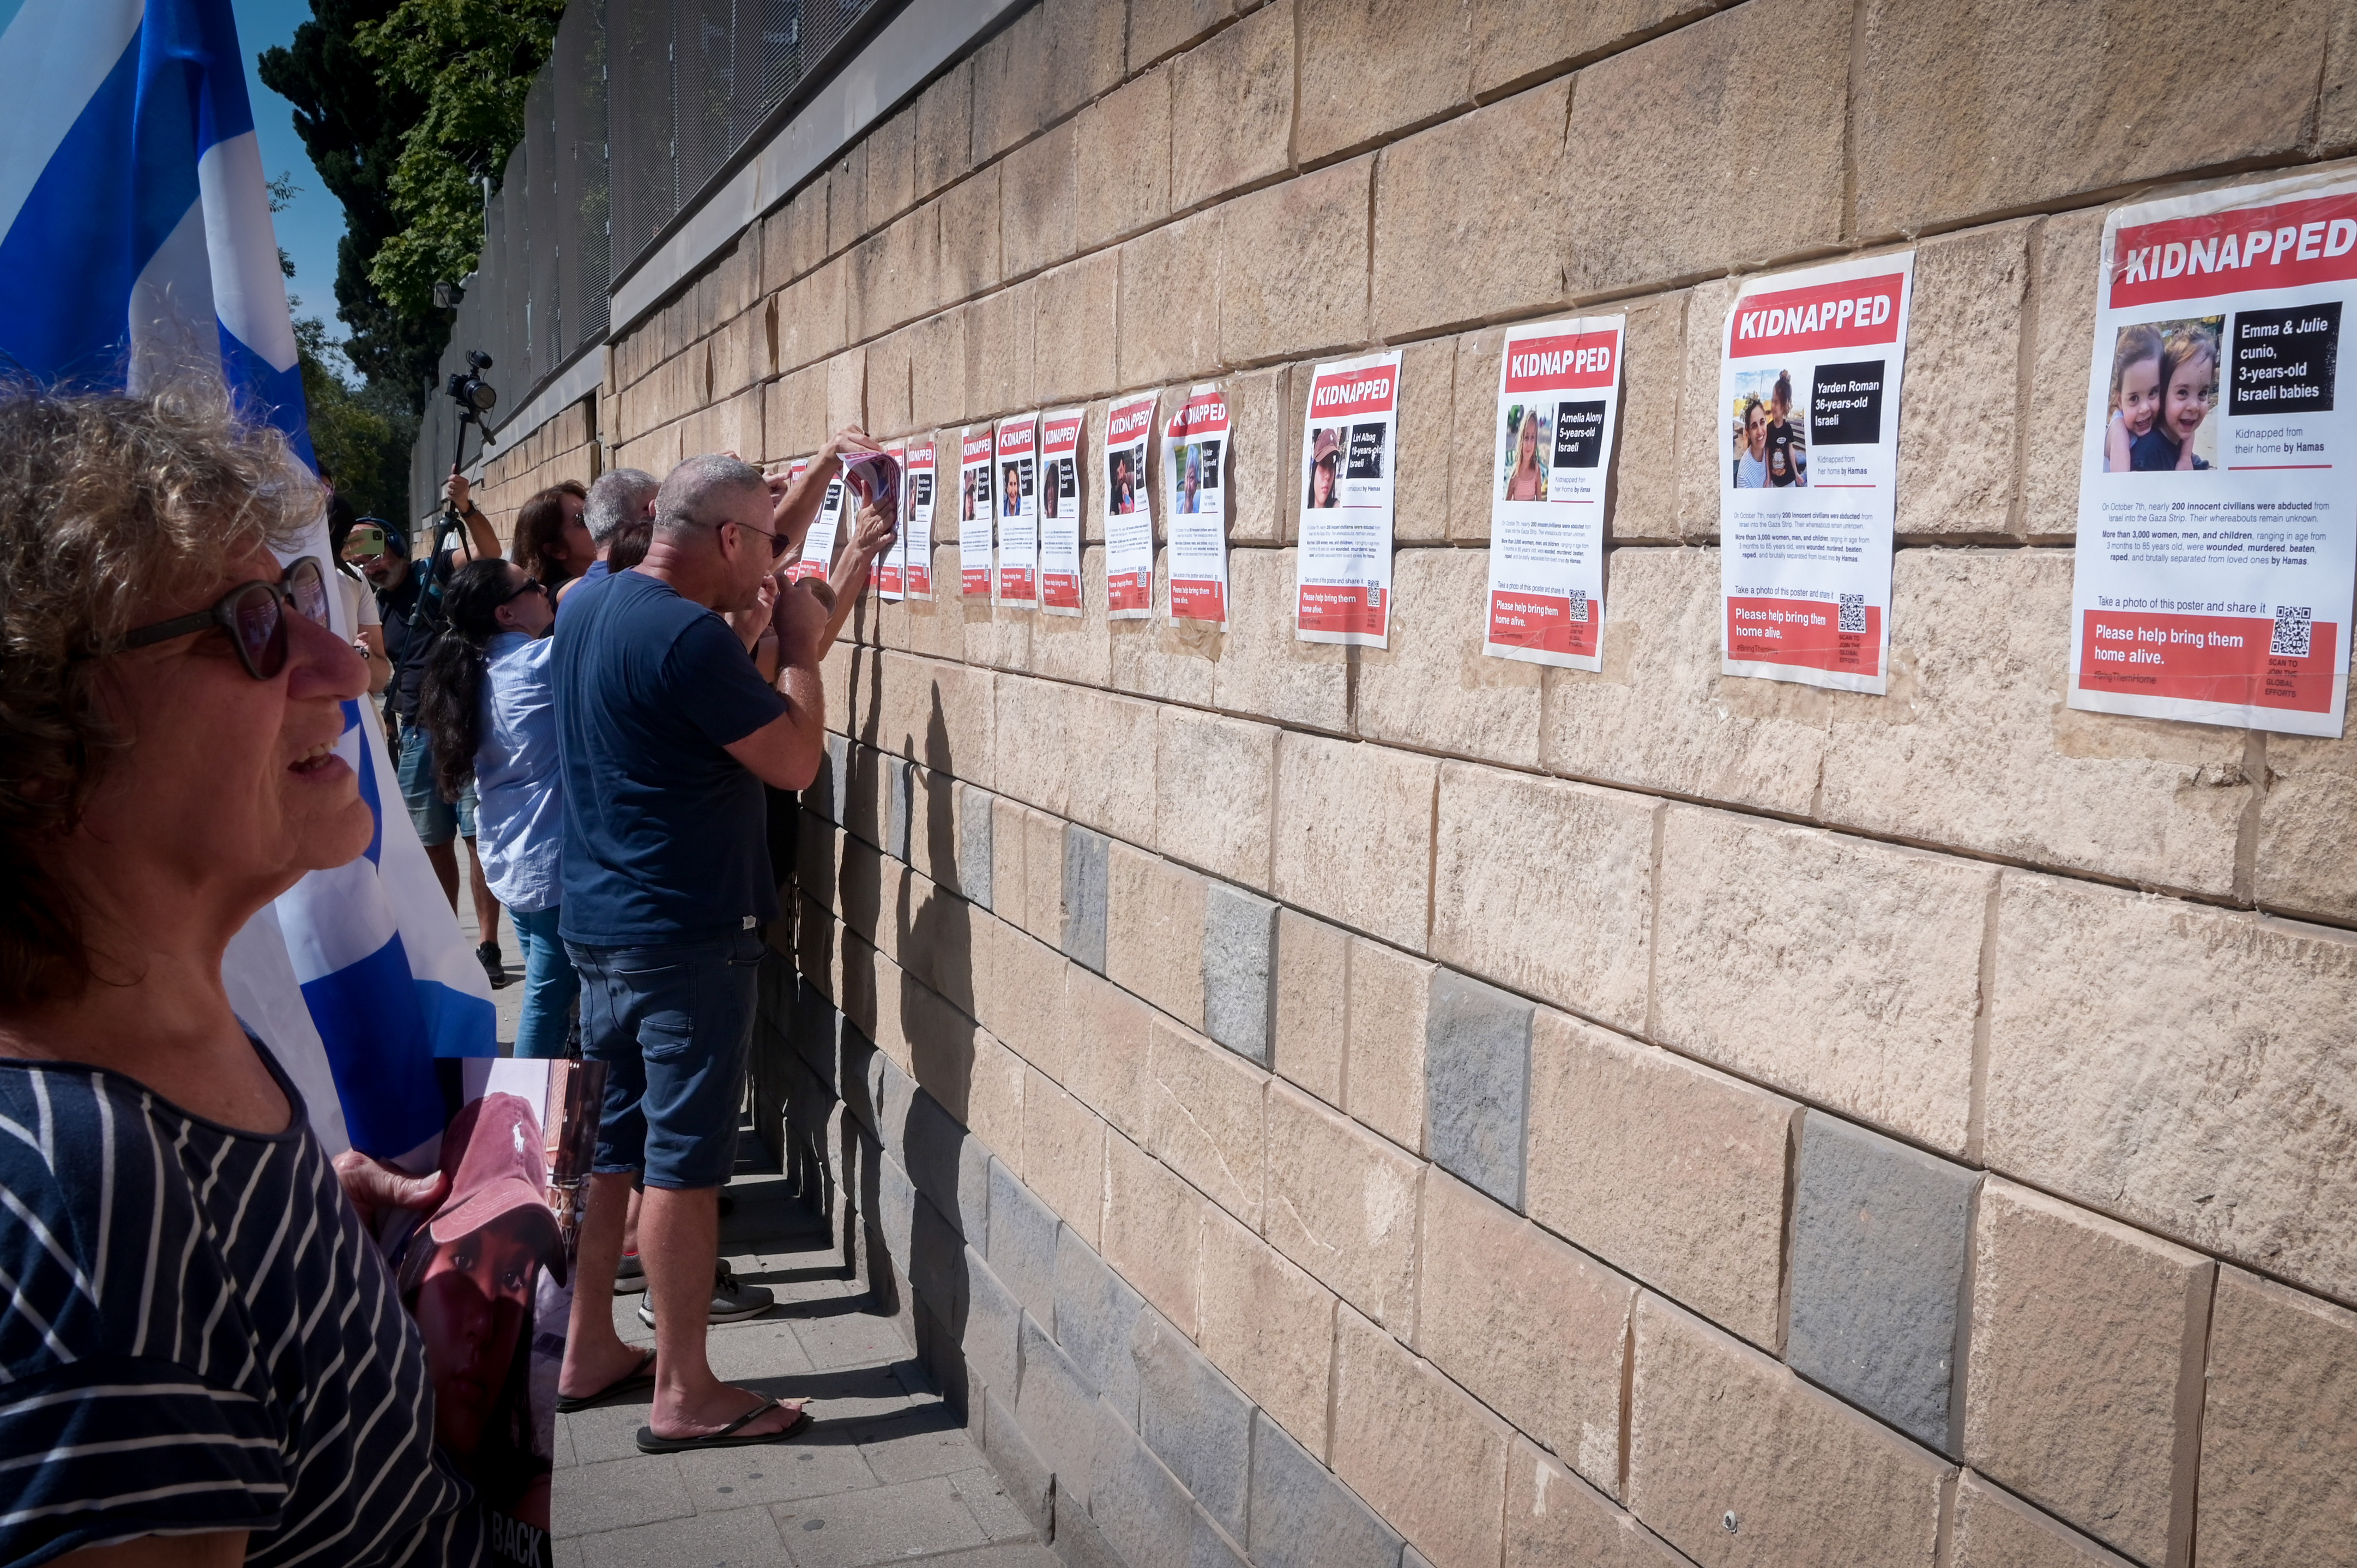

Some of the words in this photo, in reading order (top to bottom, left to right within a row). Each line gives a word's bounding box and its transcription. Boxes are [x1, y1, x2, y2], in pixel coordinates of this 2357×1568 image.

[2126, 219, 2356, 284] KIDNAPPED
[1739, 295, 1890, 339] KIDNAPPED
[2242, 324, 2279, 338] Emma
[2283, 321, 2292, 334] &
[2296, 317, 2328, 334] Julie
[2241, 344, 2276, 359] cunio,
[1511, 347, 1609, 378] KIDNAPPED
[2239, 362, 2307, 383] 3-years-old
[1316, 378, 1389, 406] KIDNAPPED
[1818, 382, 1846, 394] Yarden
[1849, 381, 1879, 391] Roman
[2238, 385, 2276, 401] Israeli
[2280, 383, 2319, 399] babies
[1816, 396, 1868, 412] 36-years-old
[1560, 413, 1584, 423] Amelia
[1586, 412, 1602, 424] Alony
[1816, 414, 1838, 426] Israeli
[1001, 429, 1032, 447] KIDNAPPED
[1045, 426, 1075, 445] KIDNAPPED
[1361, 433, 1376, 443] Albag
[1559, 427, 1595, 439] 5-years-old
[2235, 428, 2283, 439] Kidnapped
[2286, 427, 2303, 436] from
[964, 438, 991, 456] KIDNAPPED
[1558, 442, 1579, 452] Israeli
[2235, 444, 2253, 453] their
[2257, 444, 2281, 453] home
[2284, 443, 2294, 454] by
[2296, 442, 2324, 451] Hamas
[1349, 459, 1364, 468] Israeli
[1817, 456, 1843, 464] Kidnapped
[1841, 468, 1846, 476] by
[2136, 503, 2147, 511] 7th,
[2149, 503, 2169, 512] nearly
[2314, 502, 2329, 510] from
[2149, 514, 2167, 522] Gaza
[2169, 514, 2186, 523] Strip.
[2259, 514, 2283, 522] remain
[2286, 515, 2318, 523] unknown.
[2152, 532, 2179, 540] women,
[2220, 532, 2254, 540] children,
[2257, 532, 2284, 541] ranging
[2295, 533, 2308, 542] age
[2311, 532, 2326, 540] from
[2172, 543, 2184, 551] old,
[2207, 544, 2244, 552] wounded,
[2248, 544, 2287, 553] murdered,
[2289, 545, 2316, 554] beaten,
[2111, 553, 2129, 562] raped,
[2146, 554, 2168, 563] brutally
[2171, 554, 2205, 563] separated
[2227, 556, 2248, 564] loved
[2271, 556, 2280, 566] by
[2283, 557, 2308, 565] Hamas.
[1324, 593, 1337, 604] bring
[1339, 594, 1356, 602] them
[1757, 587, 1773, 596] photo
[1791, 588, 1808, 597] poster
[1819, 590, 1830, 598] share
[1497, 600, 1513, 611] Please
[1515, 602, 1526, 614] help
[1528, 604, 1544, 617] bring
[1545, 605, 1558, 616] them
[2099, 596, 2113, 606] Take
[2123, 598, 2147, 609] photo
[2150, 598, 2158, 608] of
[2161, 599, 2174, 609] this
[2177, 601, 2204, 612] poster
[2207, 601, 2224, 611] and
[2227, 602, 2256, 613] share
[2260, 603, 2265, 613] it
[1496, 614, 1510, 624] home
[1511, 617, 1526, 626] alive.
[1736, 608, 1767, 620] Please
[1769, 609, 1783, 624] help
[1786, 611, 1809, 626] bring
[1811, 613, 1826, 625] them
[1737, 625, 1762, 637] home
[1765, 626, 1782, 639] alive.
[2096, 624, 2133, 640] Please
[2138, 627, 2167, 646] help
[2171, 629, 2204, 648] bring
[2208, 631, 2243, 648] them
[2095, 646, 2125, 662] home
[2129, 649, 2164, 664] alive.
[2266, 679, 2294, 687] GLOBAL
[2265, 689, 2296, 697] EFFORTS
[493, 1510, 542, 1568] BACK
